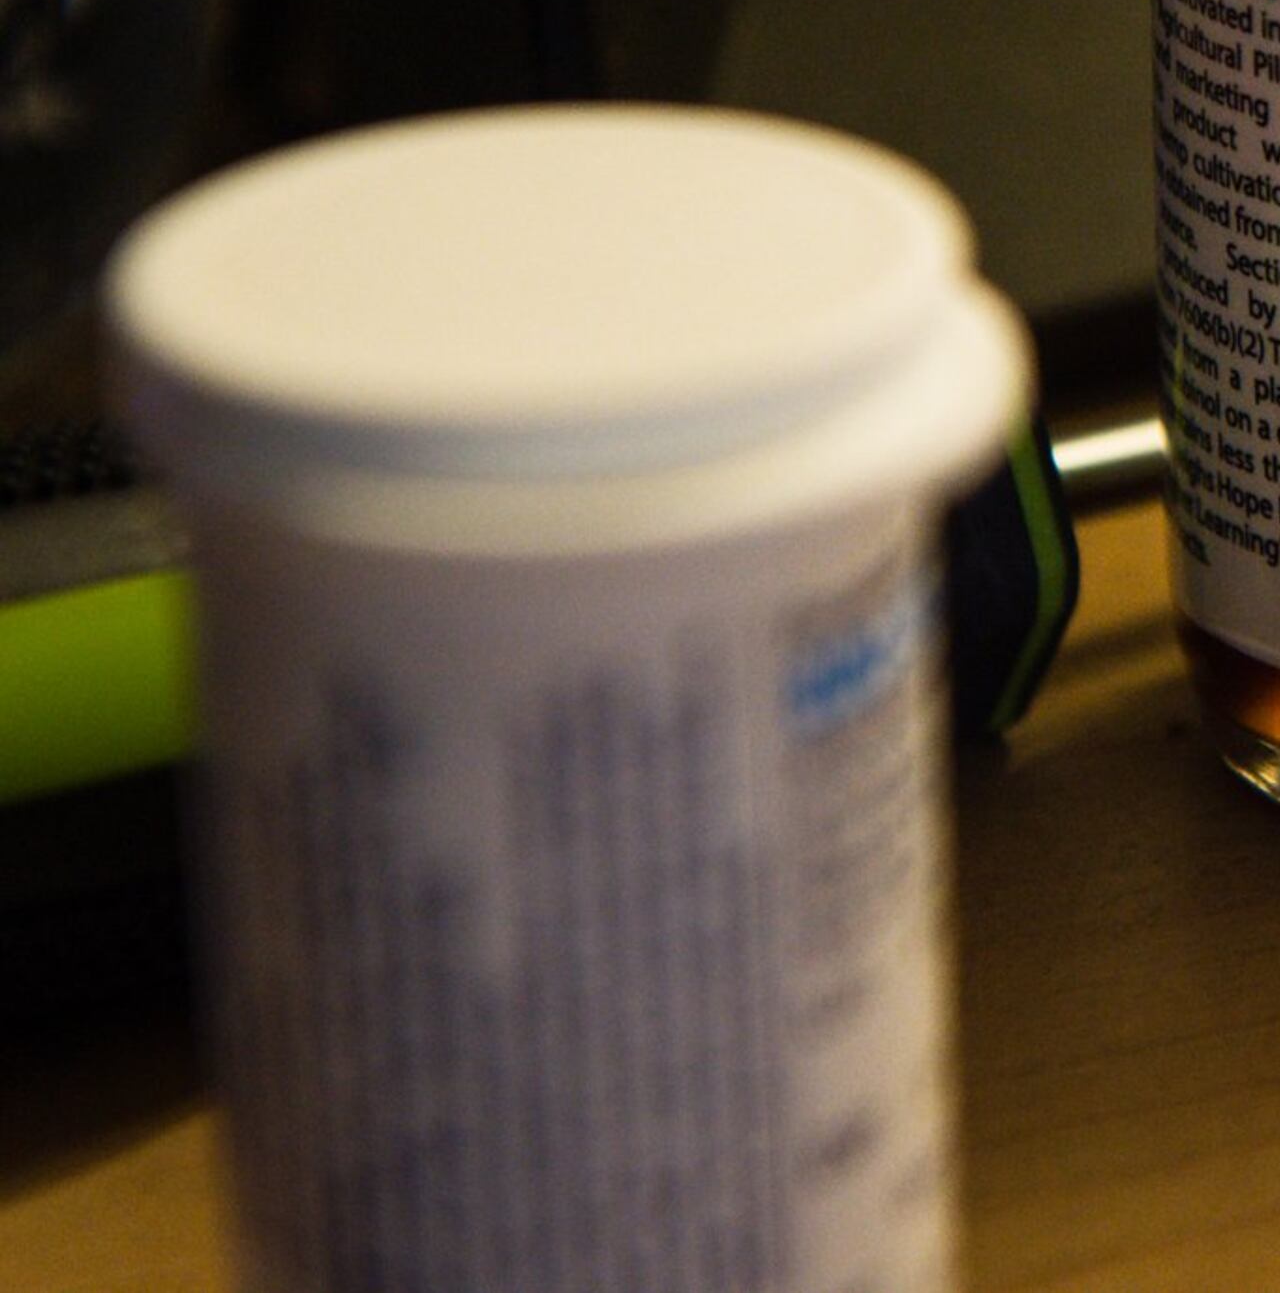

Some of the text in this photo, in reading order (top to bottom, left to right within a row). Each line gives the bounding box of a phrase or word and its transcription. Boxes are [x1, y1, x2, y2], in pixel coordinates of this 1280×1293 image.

[1175, 59, 1270, 129] marketing
[1172, 97, 1238, 151] product
[1248, 287, 1278, 331] by
[1229, 367, 1241, 392] a
[1224, 403, 1252, 434] on
[1257, 417, 1271, 441] a
[1217, 432, 1255, 475] less
[1217, 473, 1275, 520] Hope
